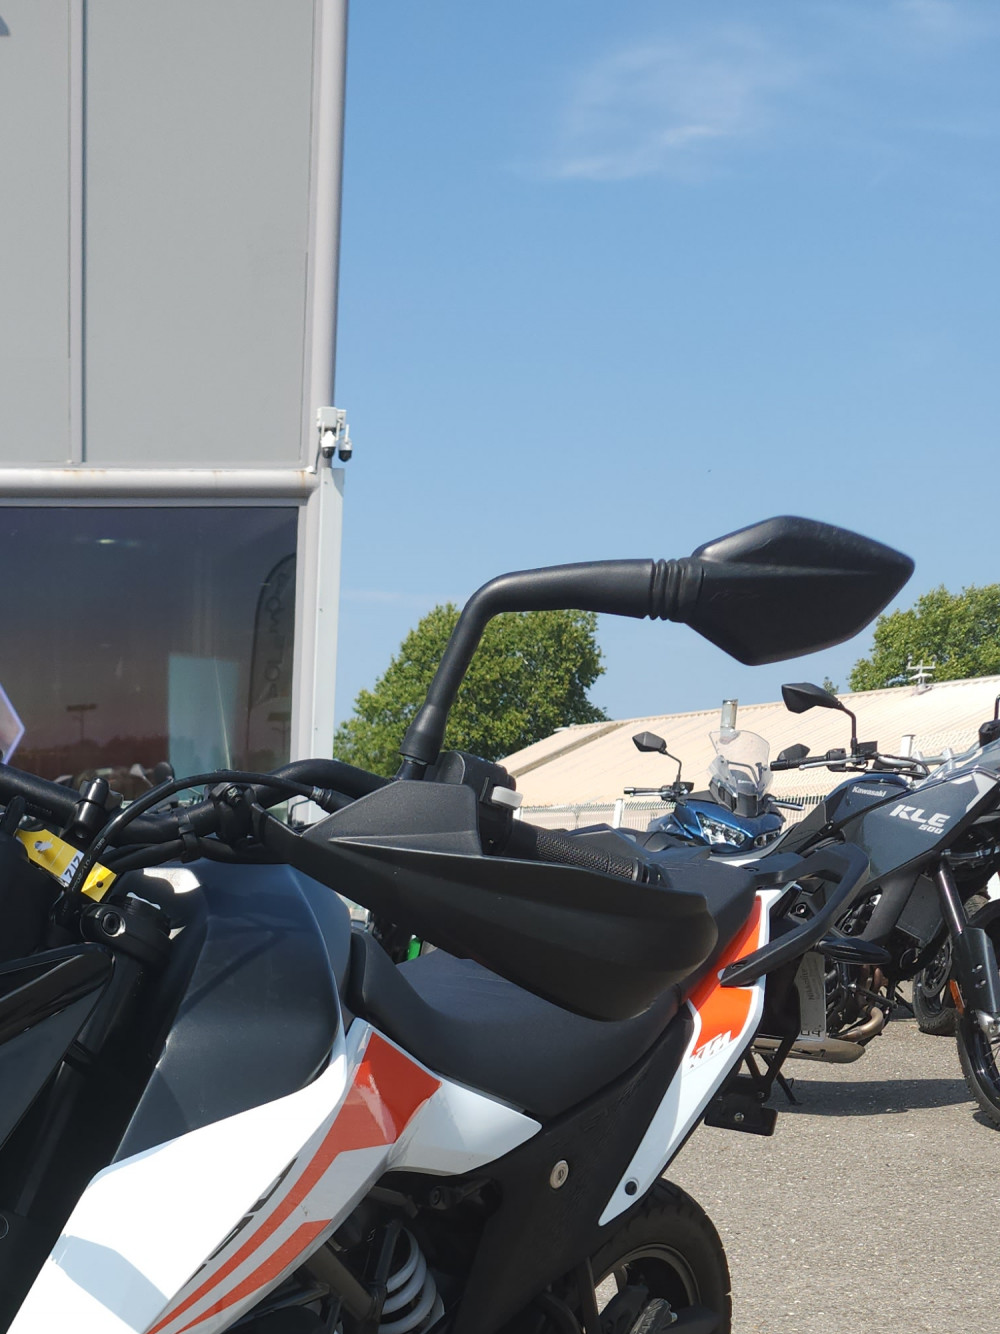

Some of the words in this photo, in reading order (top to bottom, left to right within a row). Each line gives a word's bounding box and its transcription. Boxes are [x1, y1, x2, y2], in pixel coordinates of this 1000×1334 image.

[852, 786, 887, 797] Kawasaki
[889, 804, 951, 827] KLE
[918, 824, 944, 834] 500
